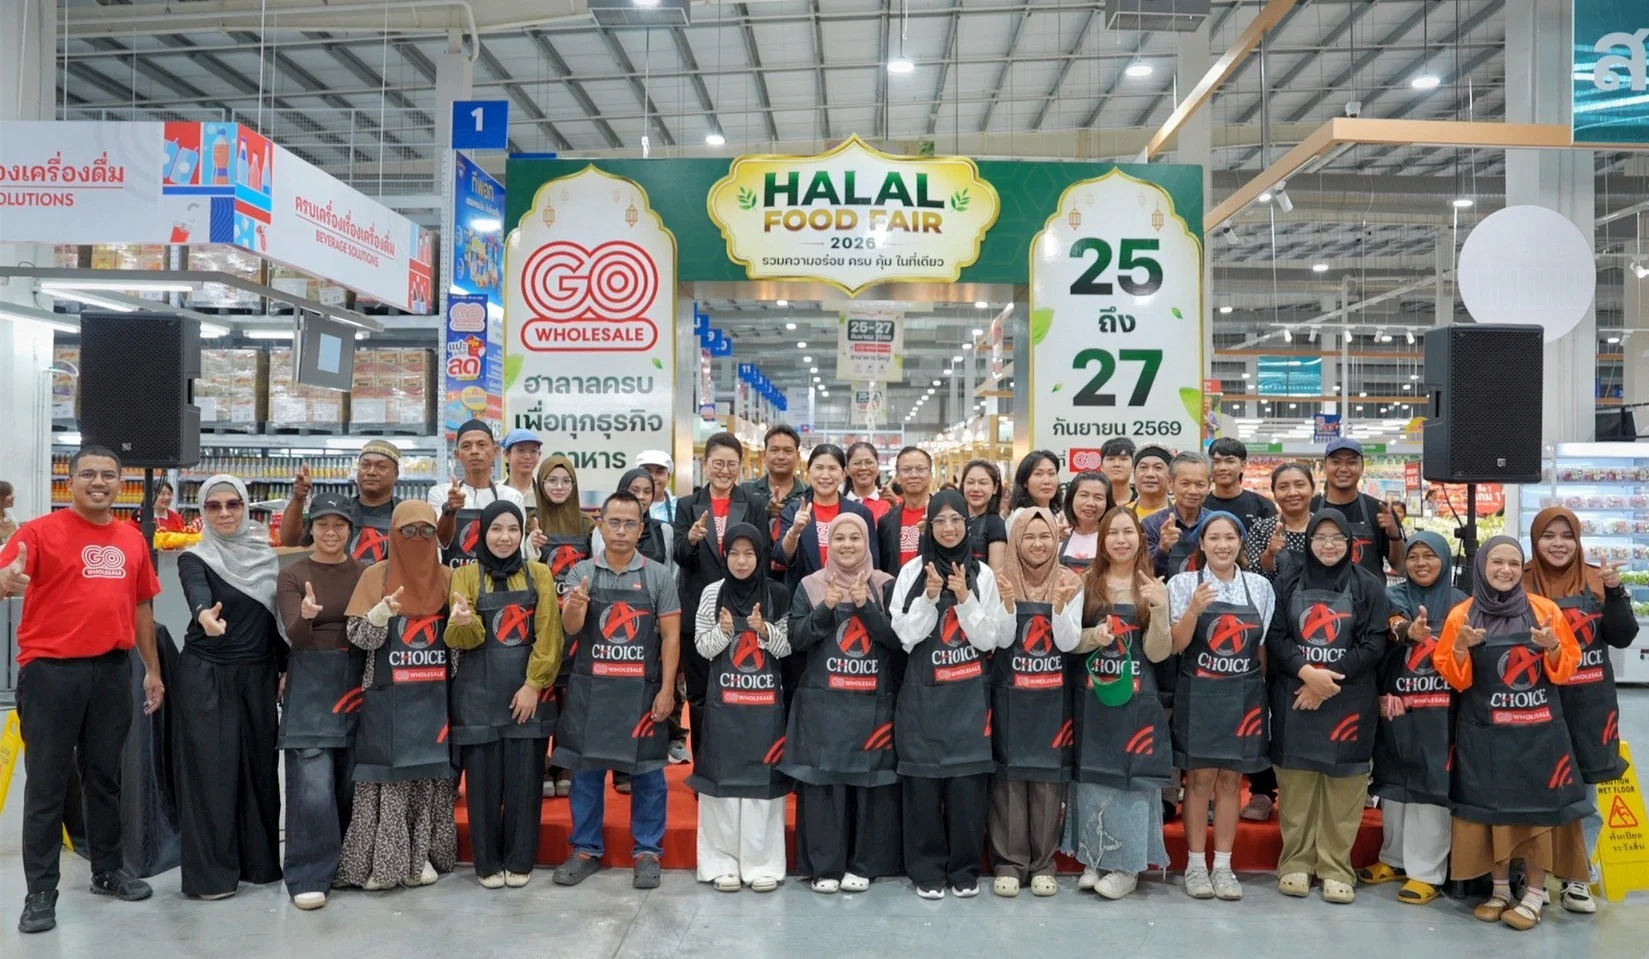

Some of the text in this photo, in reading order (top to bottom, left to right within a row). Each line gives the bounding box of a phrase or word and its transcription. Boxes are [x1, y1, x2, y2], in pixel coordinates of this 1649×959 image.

[471, 107, 483, 131] 1
[763, 170, 945, 209] HALAL
[295, 196, 395, 256] ครบเครื่องเรื่องเครื่องดื่ม
[764, 209, 943, 234] FOOD FAIR
[316, 229, 379, 268] BEVERAGE SOLUTIONS
[830, 237, 876, 249] 2026
[762, 253, 944, 270] รวมความอร่อย ครบ คุ้ม ในที่เดียว
[1069, 237, 1163, 297] 25
[521, 241, 659, 323] GO
[851, 321, 892, 334] 25-27
[1098, 307, 1136, 333] ถึง
[535, 328, 644, 342] WHOLESALE
[448, 358, 479, 375] ลด
[524, 375, 654, 394] ฮาลาลครบ
[1072, 348, 1163, 407] 27
[515, 401, 663, 439] เพื่อทุกธุรกิจ
[1053, 417, 1182, 436] กันยายน 2569
[81, 545, 125, 569] GO
[389, 650, 446, 666] CHOICE
[592, 644, 644, 660] CHOICE
[931, 645, 979, 664] CHOICE
[826, 658, 878, 674] CHOICE
[1012, 656, 1062, 672] CHOICE
[1198, 653, 1250, 673] CHOICE
[719, 673, 775, 689] CHOICE
[1490, 688, 1547, 708] CHOICE
